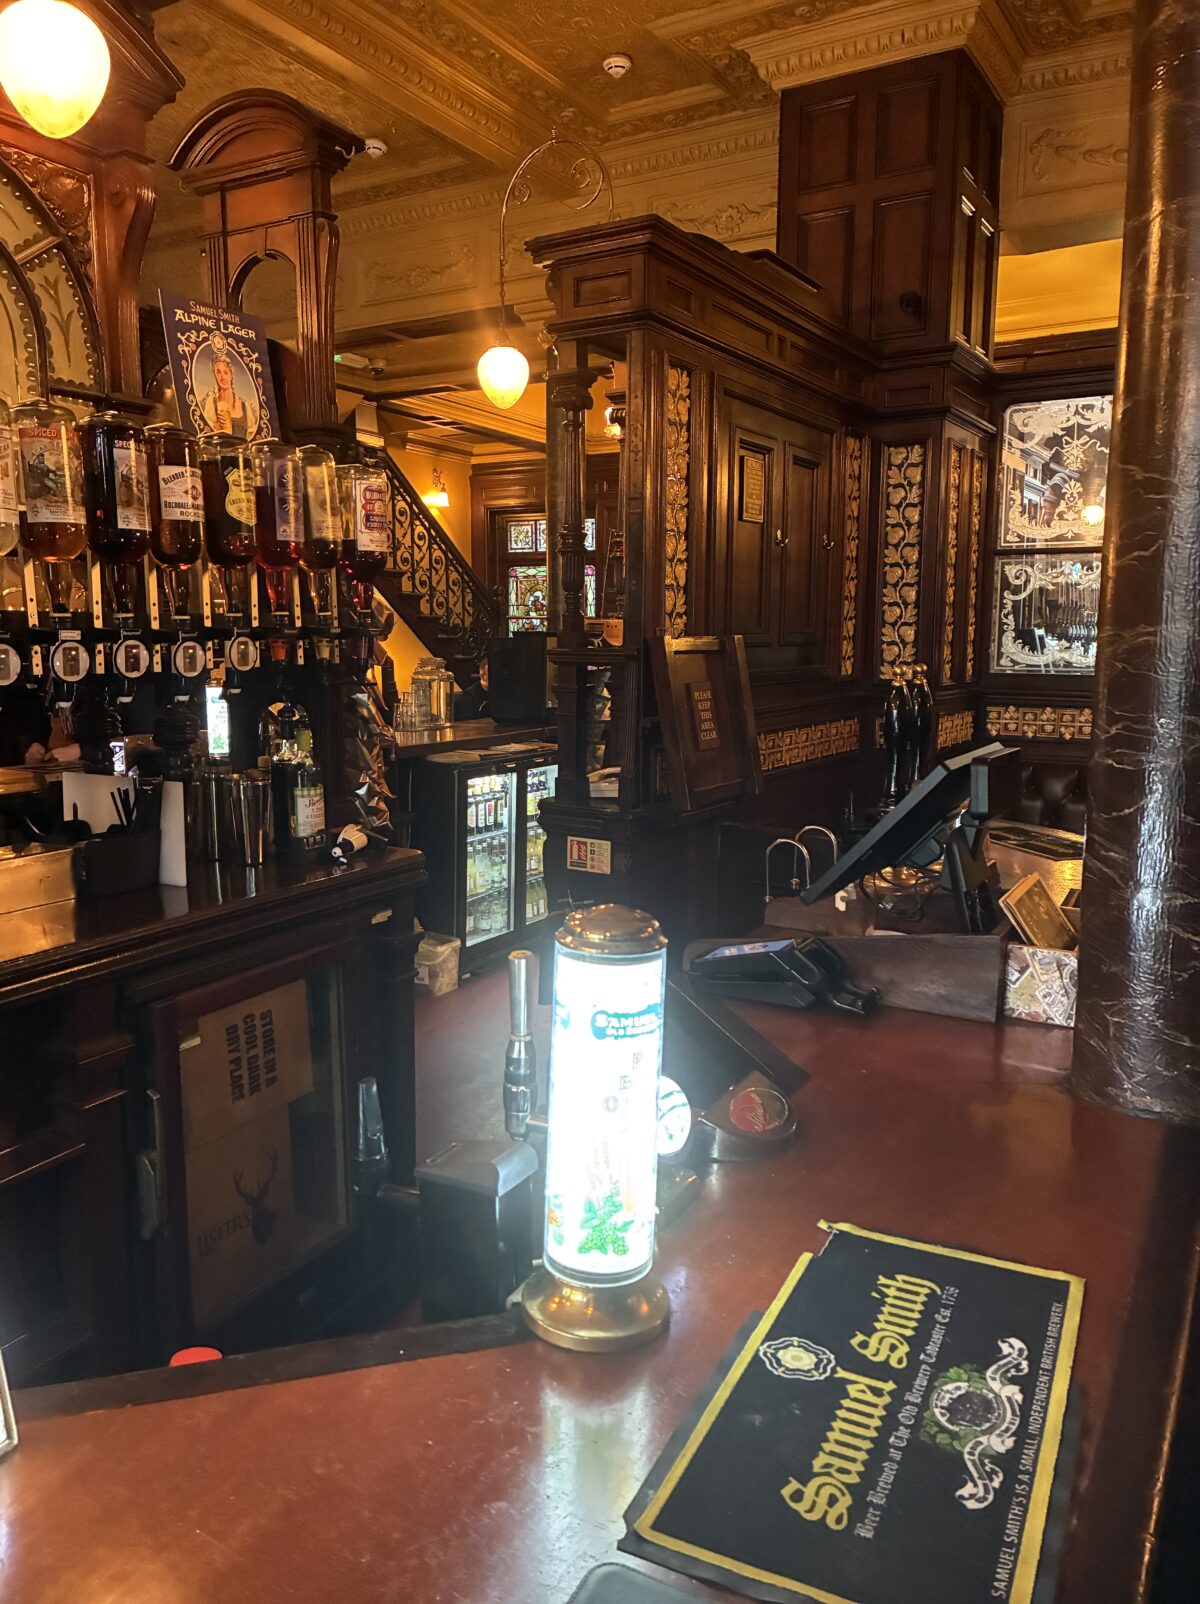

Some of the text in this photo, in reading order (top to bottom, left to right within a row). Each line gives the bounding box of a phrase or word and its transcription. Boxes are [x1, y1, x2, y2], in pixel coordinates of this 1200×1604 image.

[174, 308, 256, 340] ALPINE LAGER
[190, 300, 240, 324] SAMUEL SMITH
[29, 427, 57, 438] SPICED
[694, 690, 712, 700] PLEASE
[698, 701, 711, 710] KEEP
[700, 711, 713, 720] THIS
[701, 721, 715, 730] AREA
[701, 730, 718, 741] CLEAR
[242, 1012, 262, 1097] COOL DARK
[260, 1008, 278, 1089] STORE IN A
[225, 1023, 246, 1105] DRY PLACE
[1040, 1336, 1058, 1369] BRITISH
[903, 1363, 933, 1404] Brewery
[780, 1274, 942, 1531] Samuel Smith
[897, 1405, 919, 1425] Old
[1027, 1368, 1053, 1434] INDEPENDENT
[888, 1425, 912, 1447] The
[889, 1447, 903, 1461] at
[866, 1460, 899, 1506] Brewed
[1014, 1483, 1030, 1496] IS
[1017, 1472, 1031, 1483] A
[854, 1507, 881, 1540] Beer
[1003, 1495, 1027, 1545] SMITH'S
[991, 1546, 1016, 1600] SAMUEL
